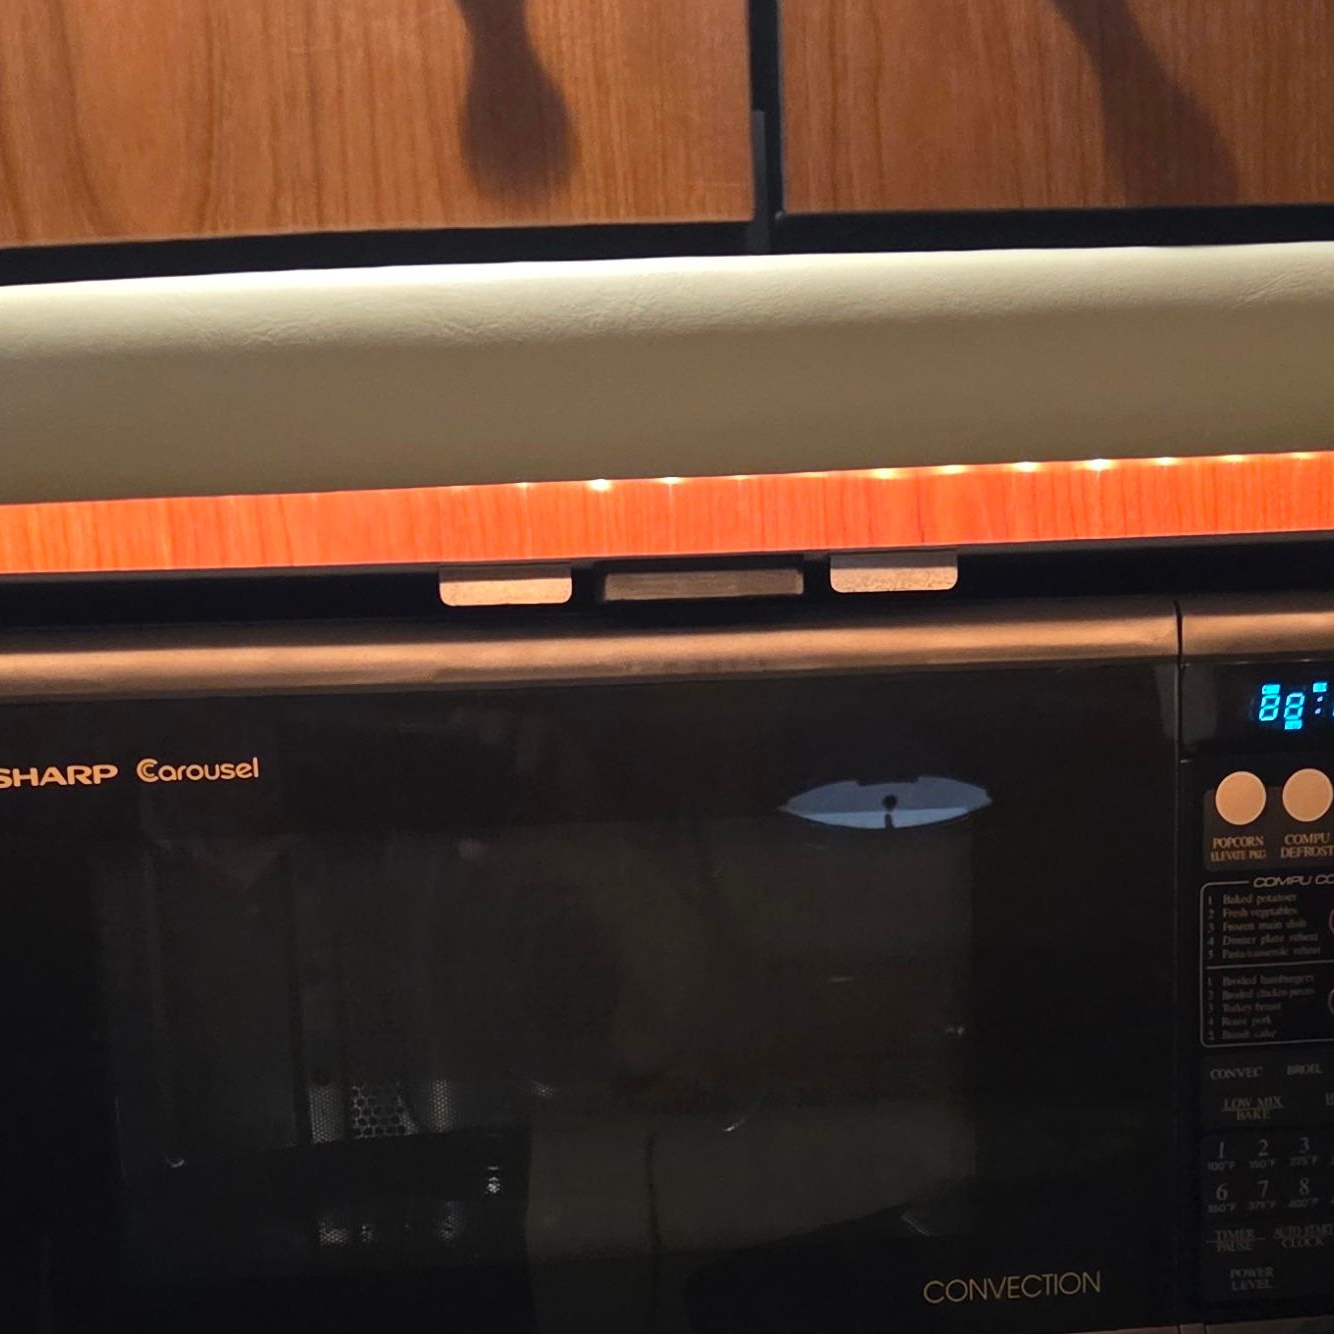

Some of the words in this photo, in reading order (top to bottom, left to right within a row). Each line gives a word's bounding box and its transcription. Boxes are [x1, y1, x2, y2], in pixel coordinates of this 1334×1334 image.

[136, 756, 260, 783] Carousel
[1212, 835, 1265, 850] POPCORN
[1283, 832, 1331, 846] COMPU
[1252, 874, 1313, 889] COMPU
[1210, 1067, 1264, 1081] CONVEC
[1286, 1063, 1323, 1076] BROIL
[1223, 1097, 1252, 1110] LOW
[1257, 1095, 1284, 1109] MIX
[1218, 1141, 1225, 1159] 1
[1257, 1139, 1269, 1157] 2
[1299, 1136, 1310, 1154] 3
[1215, 1183, 1228, 1201] 6
[1257, 1180, 1270, 1198] 7
[1299, 1177, 1310, 1196] 8
[1281, 1237, 1324, 1249] CLOCK
[1230, 1266, 1275, 1279] POWER
[923, 1271, 1101, 1304] CONVECTION
[1231, 1279, 1273, 1291] LEVEL
